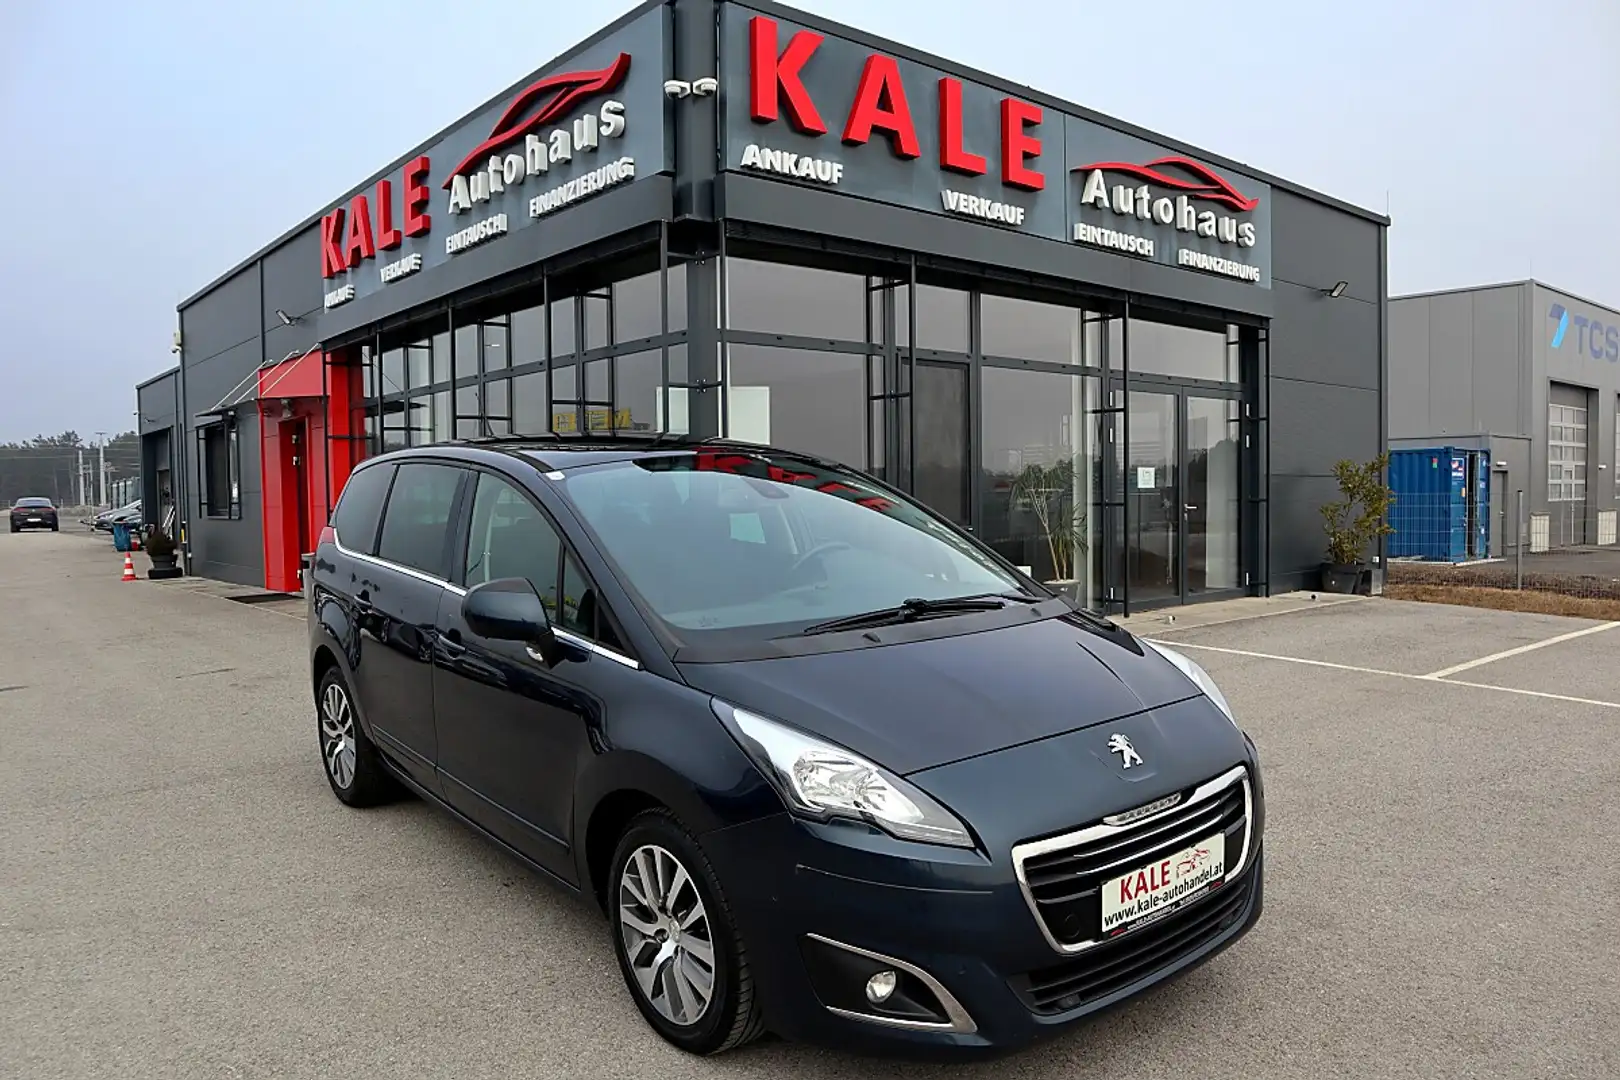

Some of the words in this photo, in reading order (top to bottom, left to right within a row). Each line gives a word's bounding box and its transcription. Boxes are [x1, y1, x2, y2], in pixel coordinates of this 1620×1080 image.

[748, 16, 1046, 192] KALE
[445, 213, 508, 254] EINTAUSCH
[529, 156, 636, 218] FINANZIERUNG
[448, 100, 626, 214] Autohaus
[320, 156, 431, 279] KALE
[741, 144, 844, 185] ANKAUF
[941, 189, 1025, 226] VERKAUF
[1073, 223, 1154, 257] EINTAUSCH
[1178, 248, 1261, 283] FINANZIERUNG
[1080, 169, 1257, 248] Autohaus
[1574, 314, 1619, 363] TCS
[1104, 862, 1223, 927] www.kale-autohandel.at
[1120, 860, 1171, 904] KALE
